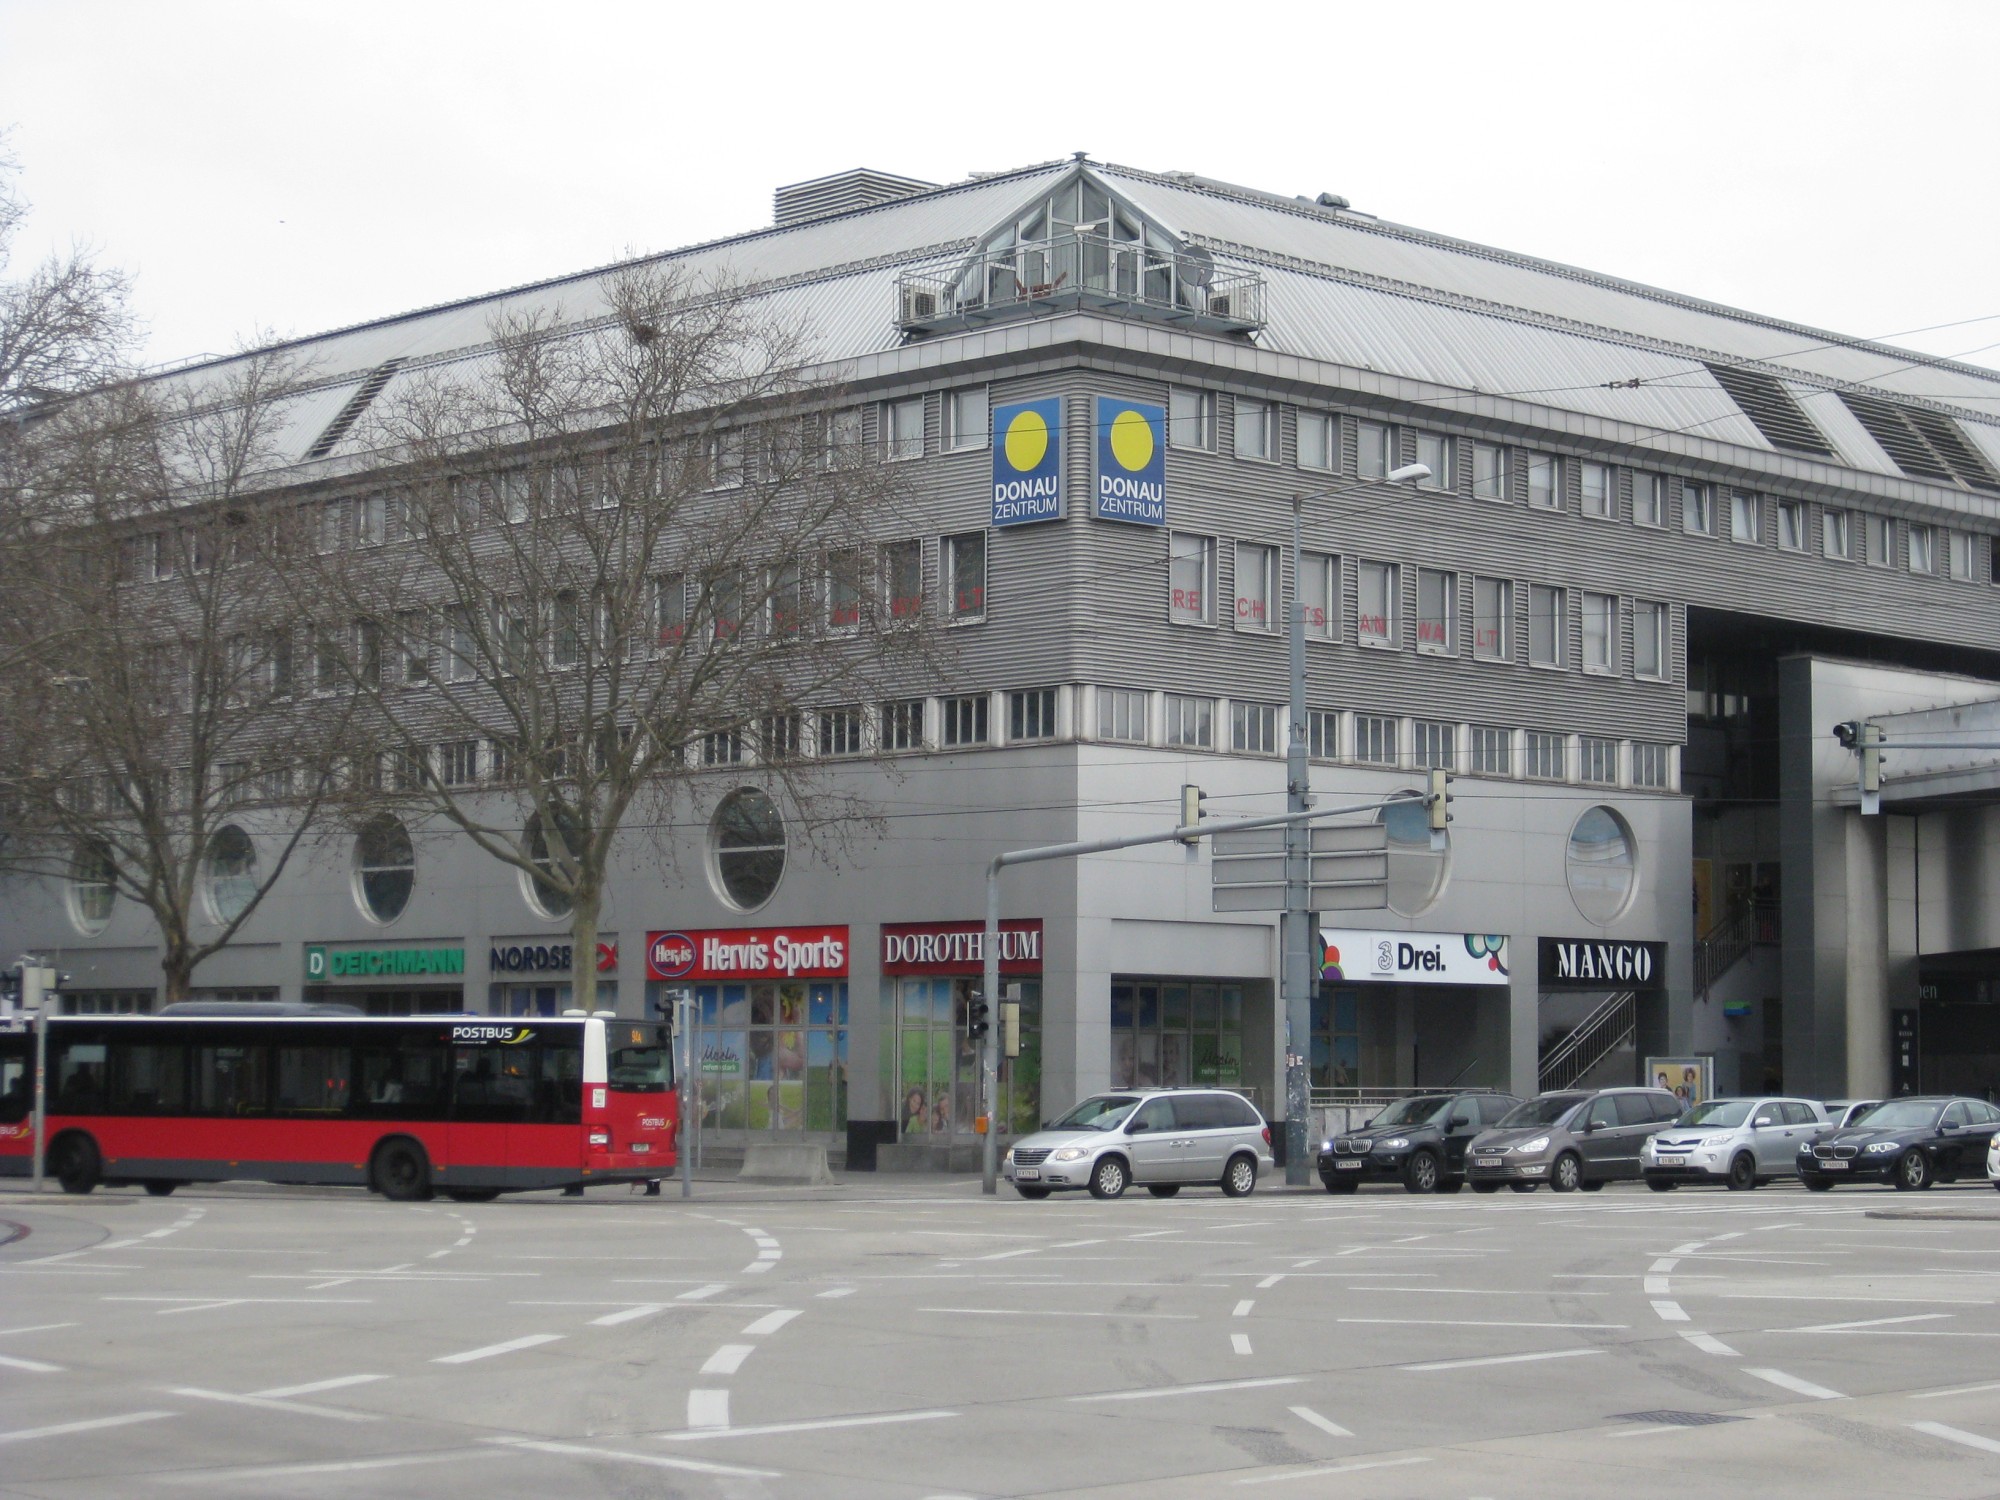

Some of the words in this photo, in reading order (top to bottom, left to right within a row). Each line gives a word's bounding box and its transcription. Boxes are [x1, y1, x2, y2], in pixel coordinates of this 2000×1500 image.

[995, 476, 1057, 502] DONAU
[1100, 475, 1162, 502] DONAU
[994, 497, 1057, 519] ZENTRUM
[1100, 496, 1163, 520] ZENTRUM
[491, 945, 572, 971] NORDSE
[655, 945, 692, 966] Hervis
[703, 936, 769, 971] Hervis
[773, 935, 844, 976] Sports
[885, 931, 1040, 962] DOROTHUM
[331, 948, 464, 976] DEICHMANN
[1557, 943, 1651, 981] MANGO
[452, 1027, 513, 1039] POSTBUS
[641, 1118, 665, 1127] POSTBUS
